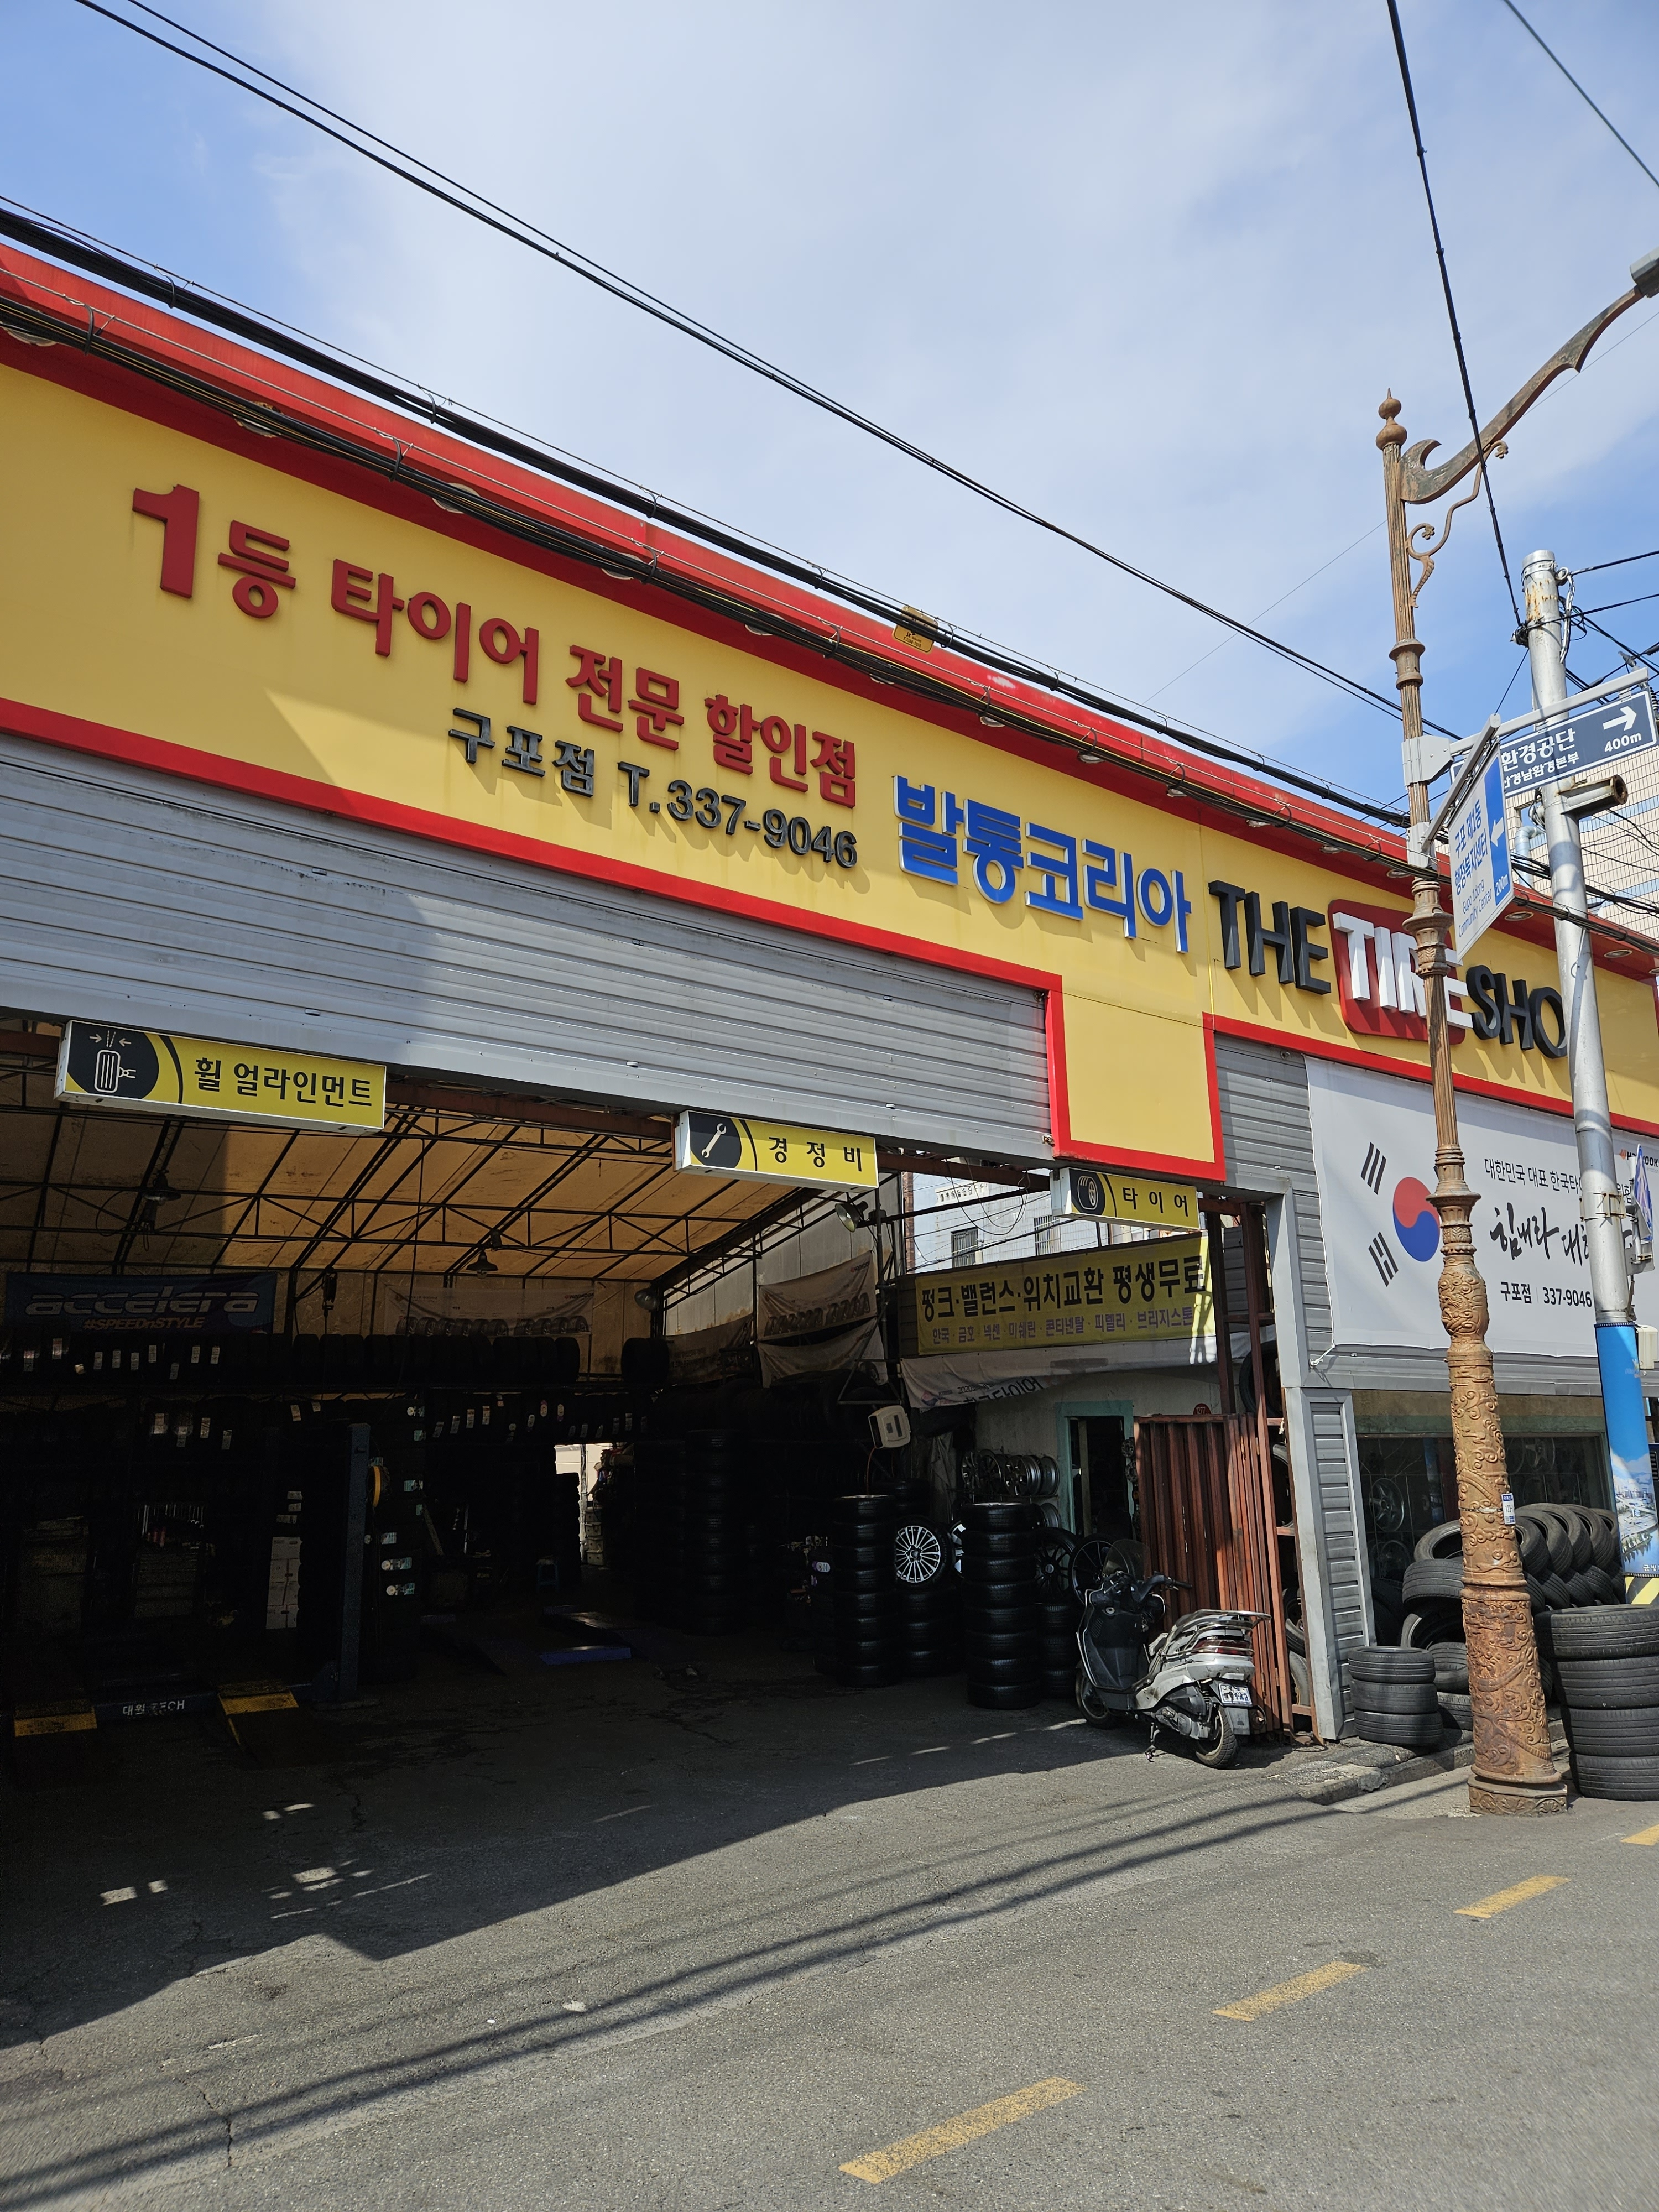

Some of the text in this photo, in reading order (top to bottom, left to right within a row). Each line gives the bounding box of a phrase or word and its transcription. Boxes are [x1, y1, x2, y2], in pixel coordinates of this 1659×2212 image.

[132, 484, 856, 808] 1등 타이어 전문 할인점
[448, 708, 594, 798] 구포점
[1502, 728, 1642, 772] 환경공단 400m
[1504, 752, 1579, 789] 산경남환경본부
[1455, 798, 1481, 859] 구포 제1동
[893, 774, 1192, 954] 발통코리아
[1454, 828, 1488, 895] 행정복지센터
[1495, 874, 1509, 896] 200m
[1458, 888, 1492, 938] Community Center
[1463, 894, 1473, 914] Gupo
[1209, 880, 1332, 995] THE
[194, 1057, 372, 1107] 휠 얼라인먼트
[1484, 1159, 1525, 1185] 대한민국
[1528, 1167, 1548, 1188] 대표
[1490, 1202, 1559, 1260] 힘내라
[25, 1285, 259, 1316] accelera
[1113, 1255, 1206, 1304] 평생무료
[1500, 1281, 1592, 1307] 구포점 337-9046
[932, 1328, 949, 1344] 한국
[958, 1325, 975, 1343] 금호
[984, 1323, 1000, 1341] 넥센
[1009, 1321, 1036, 1339] 미쉐린
[1095, 1313, 1125, 1332] 피렐리
[1138, 1307, 1193, 1329] 브리지스톤
